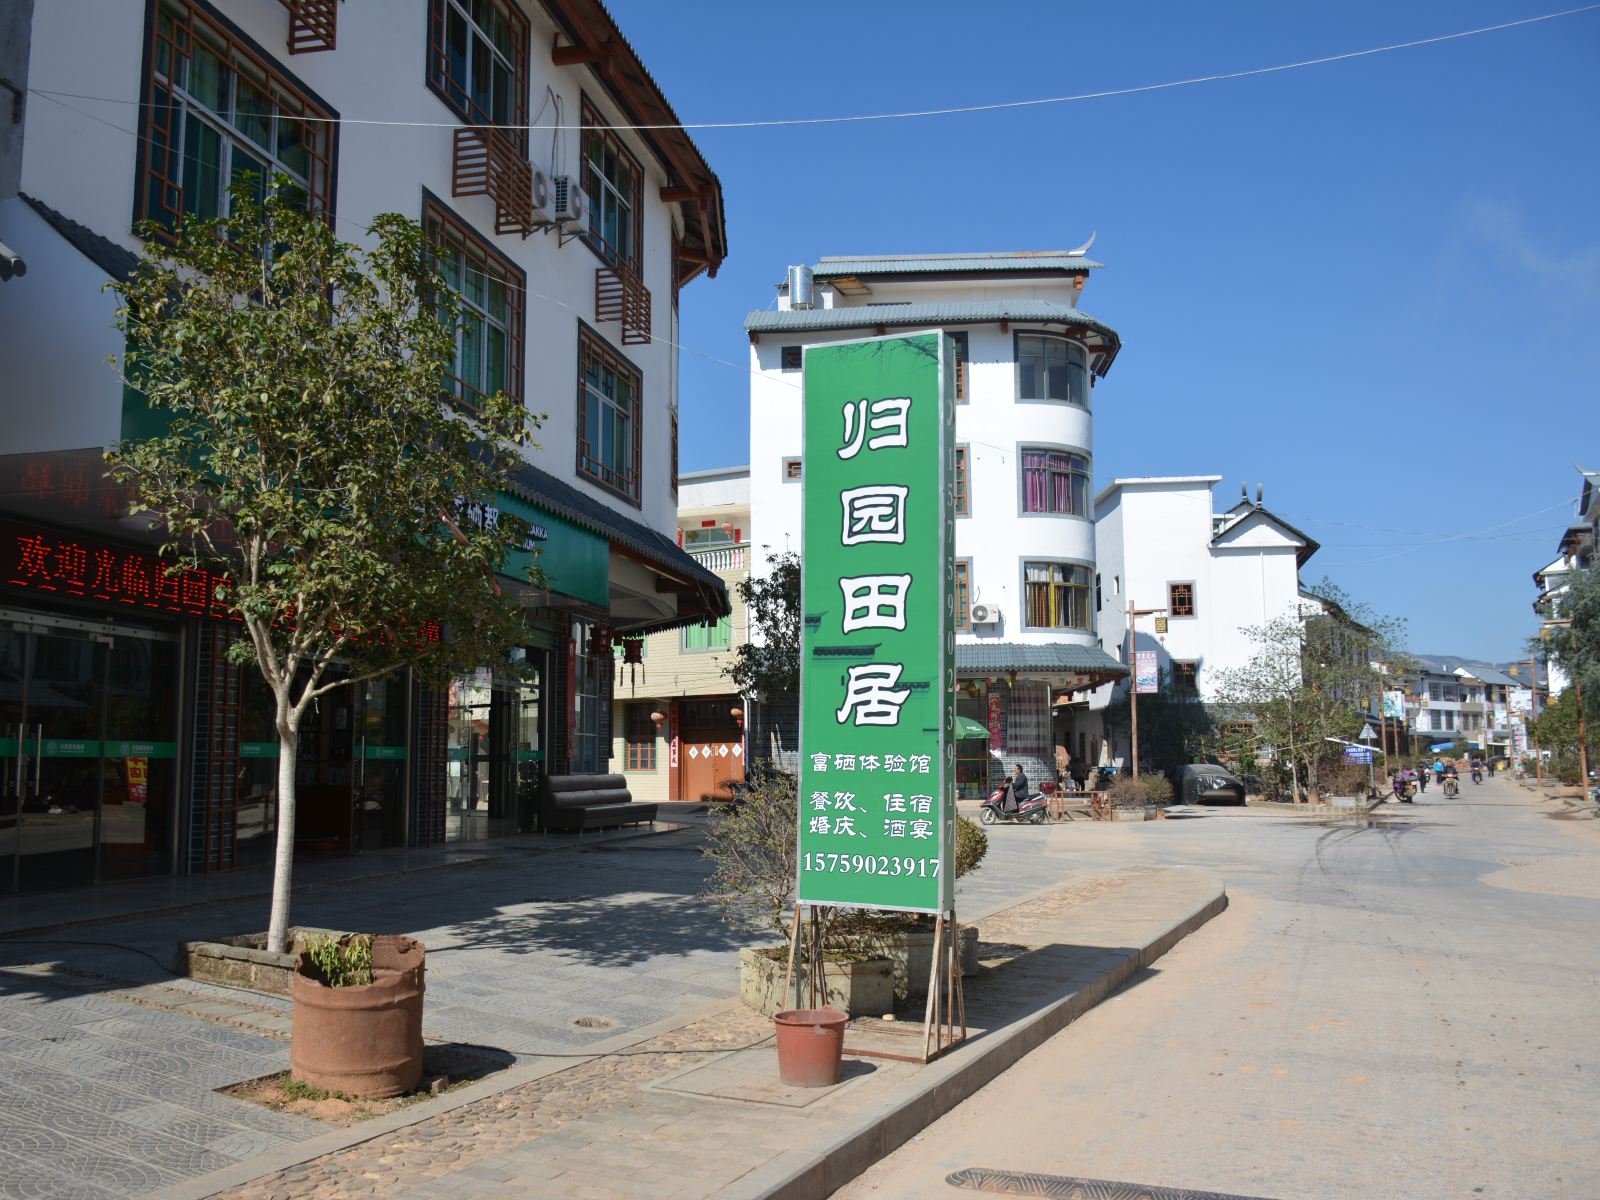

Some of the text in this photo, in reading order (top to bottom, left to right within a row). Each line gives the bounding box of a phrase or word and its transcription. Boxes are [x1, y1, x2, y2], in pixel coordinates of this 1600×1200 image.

[836, 396, 913, 727] 归园田居
[945, 447, 954, 846] 15759023917
[810, 752, 931, 774] 富硒体验馆
[883, 793, 933, 815] 住宿
[883, 818, 933, 840] 酒宴
[803, 852, 939, 879] 15759023917
